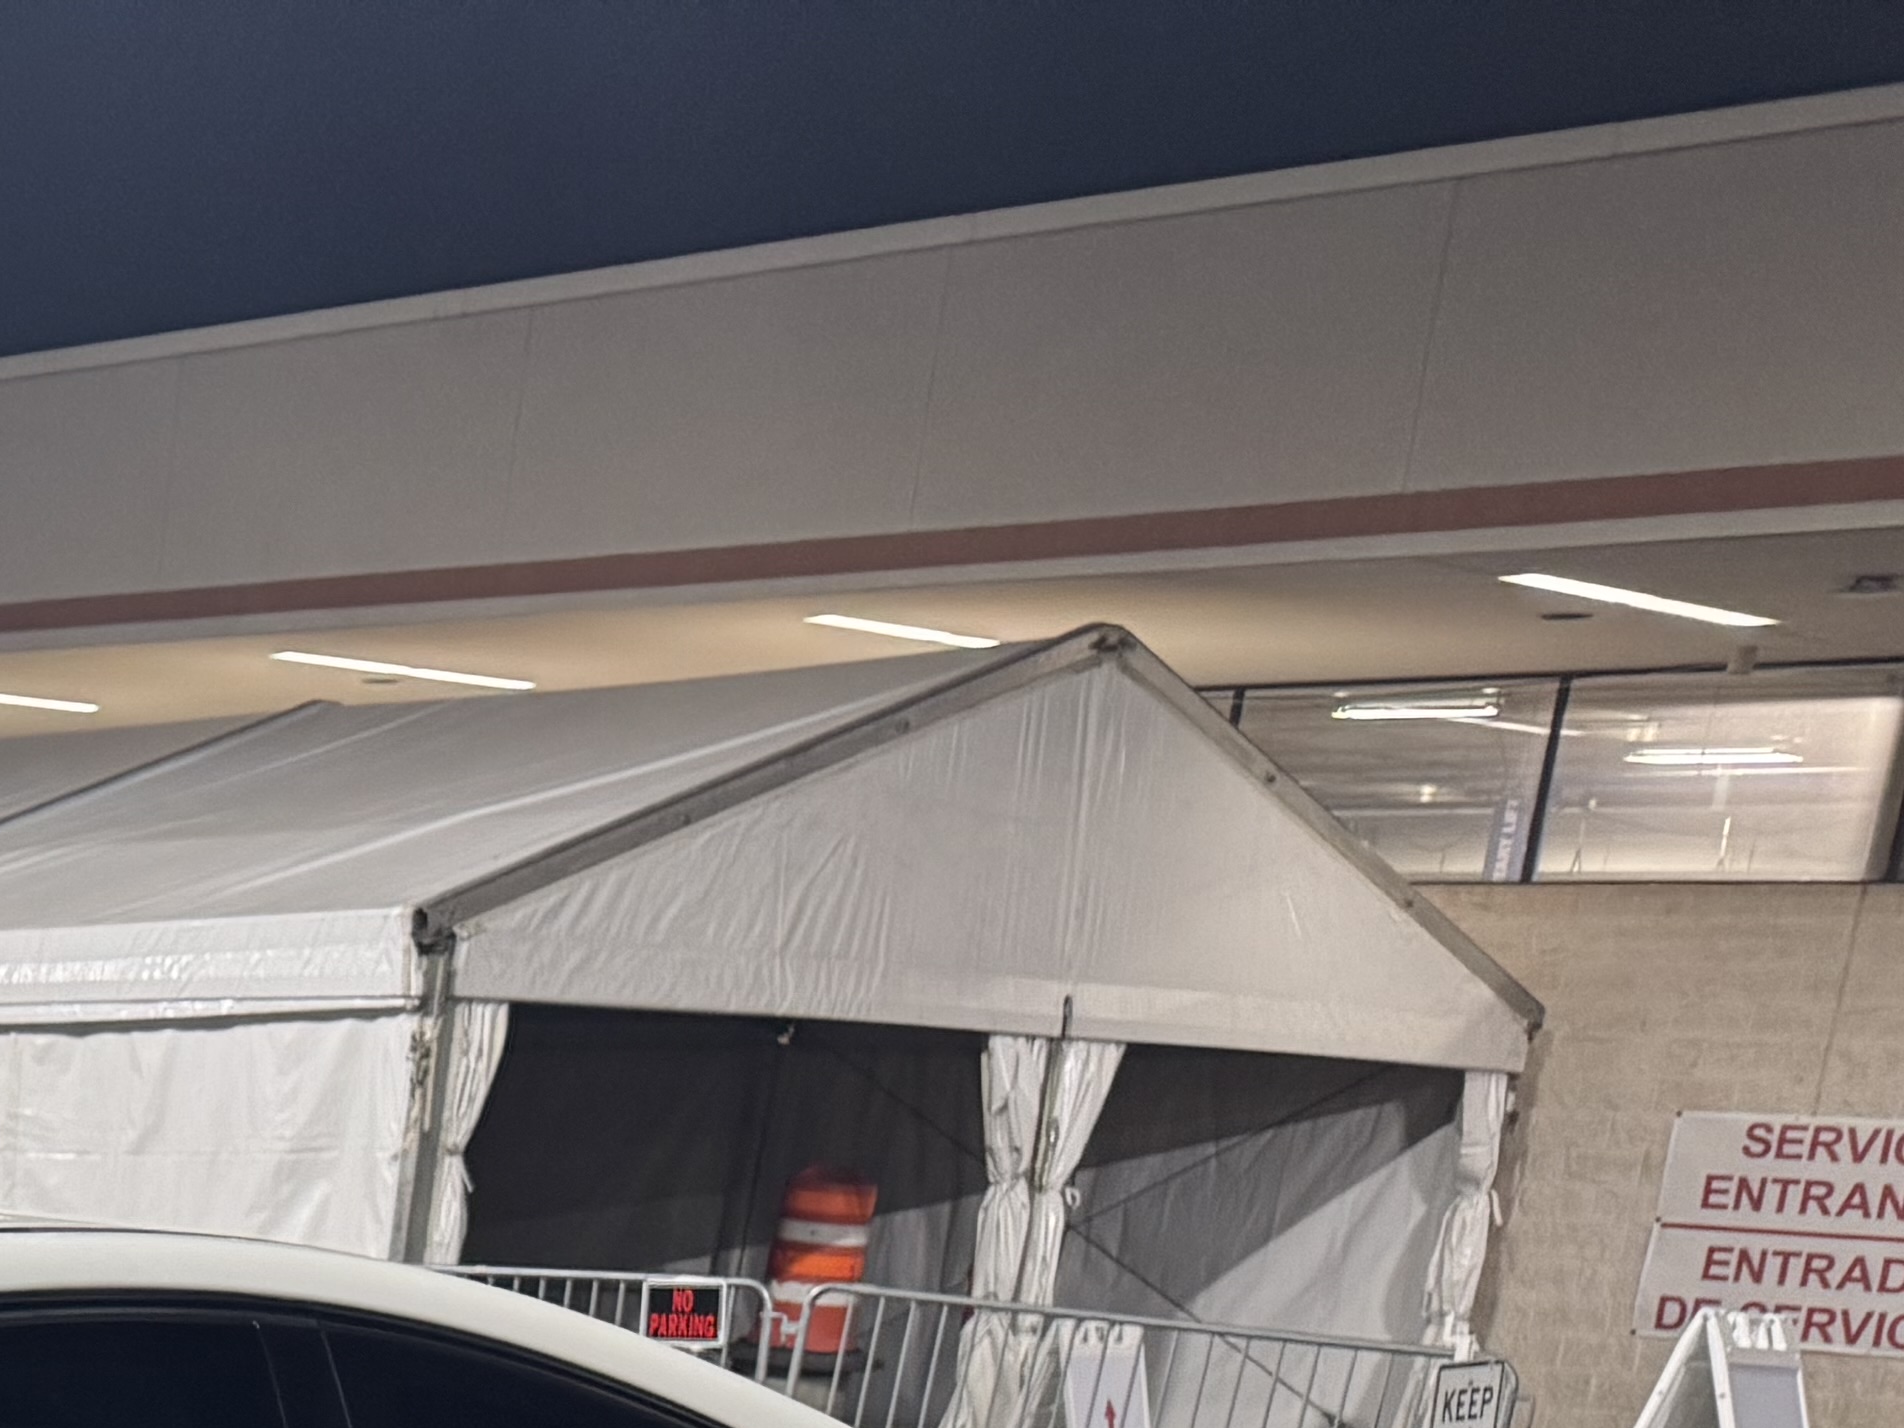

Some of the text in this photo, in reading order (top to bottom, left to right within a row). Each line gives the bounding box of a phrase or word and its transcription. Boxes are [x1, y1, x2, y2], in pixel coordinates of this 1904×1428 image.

[1741, 1122, 1904, 1166] SERVI
[1701, 1245, 1904, 1293] ENTRAD
[673, 1288, 695, 1313] NO
[649, 1313, 715, 1338] PARKING
[1442, 1386, 1493, 1423] KEEP
